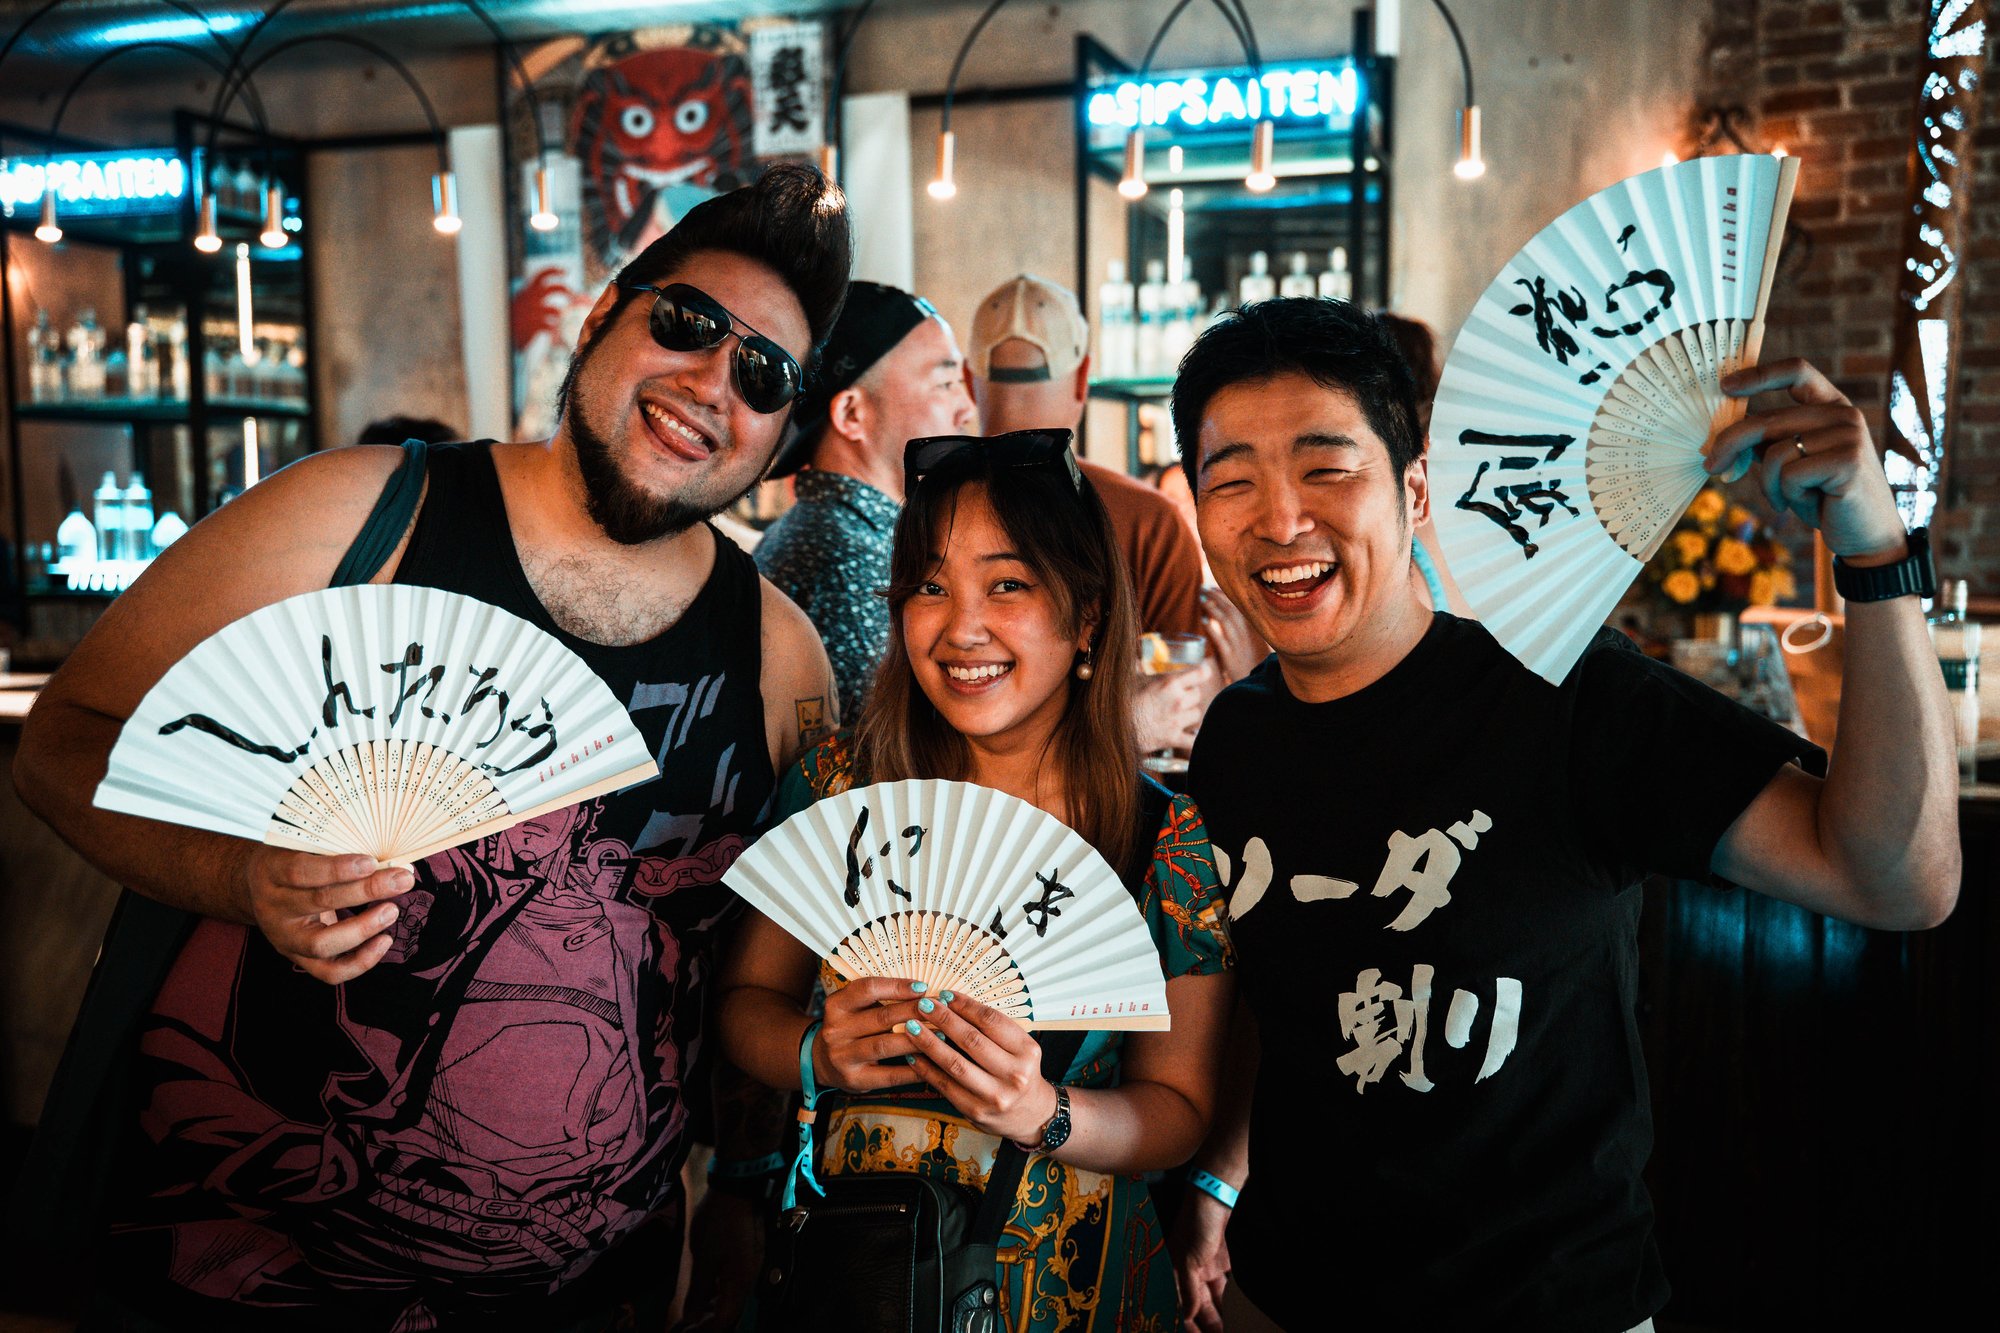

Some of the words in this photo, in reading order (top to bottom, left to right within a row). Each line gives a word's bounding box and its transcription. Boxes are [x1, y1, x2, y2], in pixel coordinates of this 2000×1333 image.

[1722, 187, 1737, 283] iichiko
[539, 734, 614, 783] iichiko
[1212, 809, 1493, 932] ソーダ
[1071, 1002, 1150, 1017] iichiko
